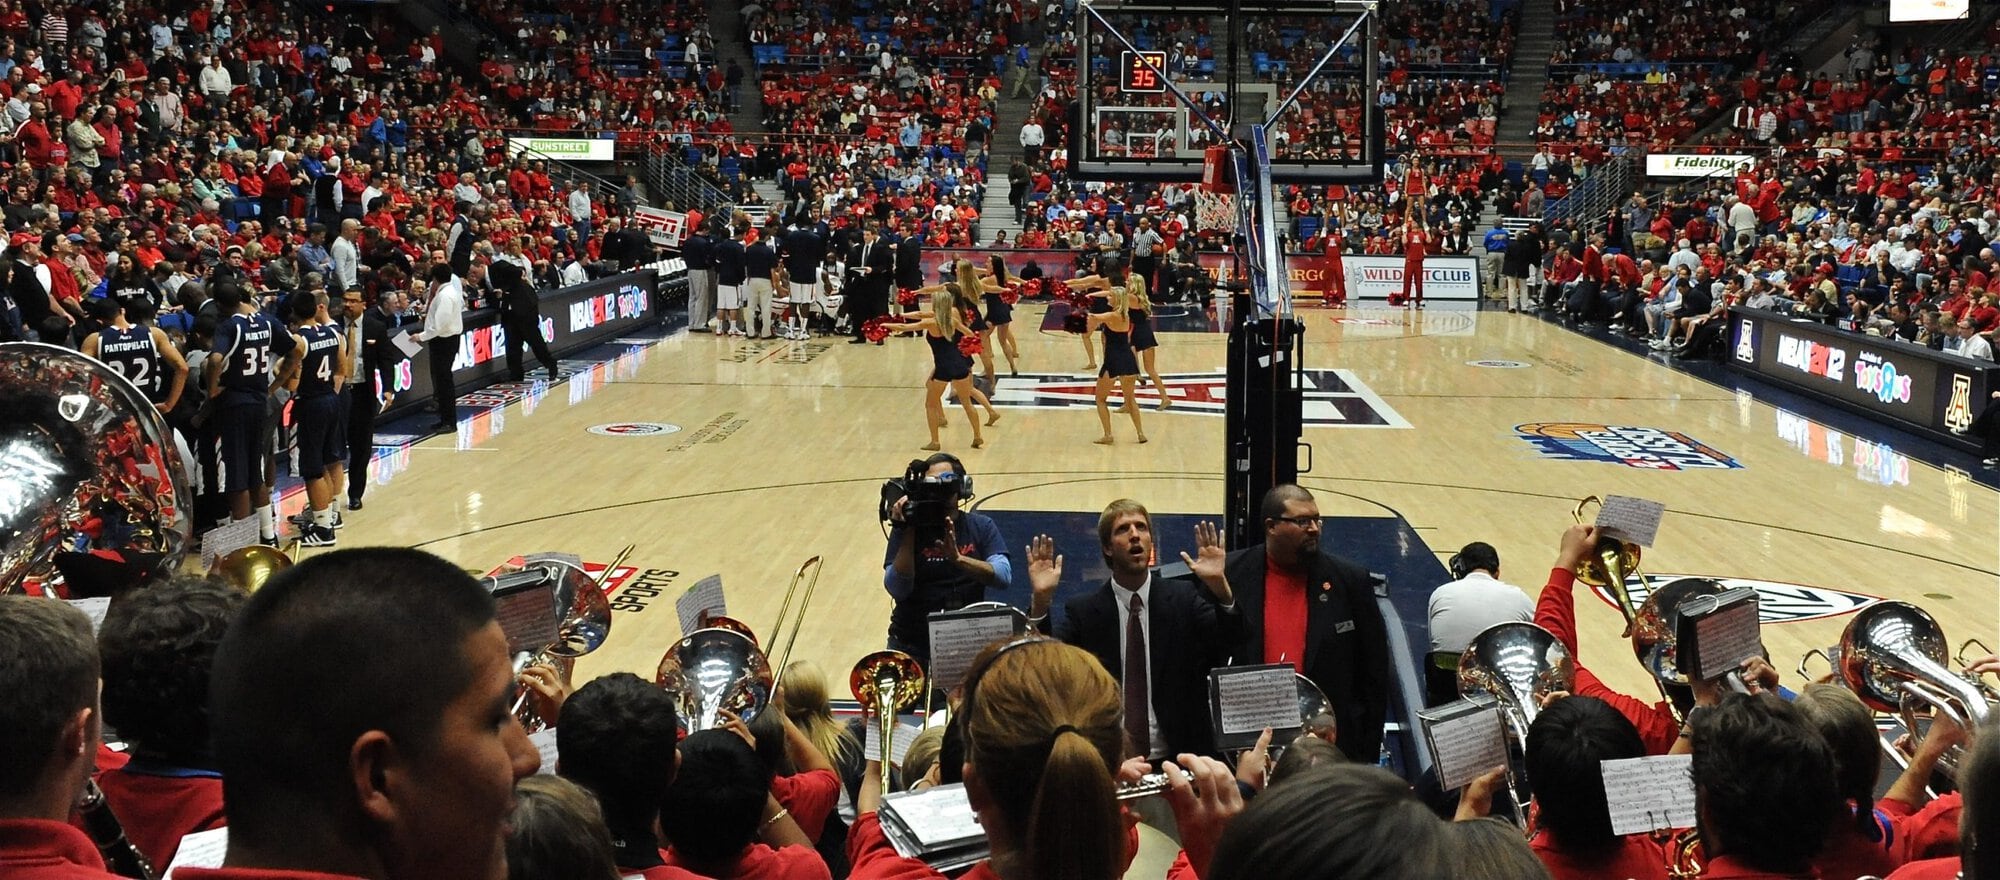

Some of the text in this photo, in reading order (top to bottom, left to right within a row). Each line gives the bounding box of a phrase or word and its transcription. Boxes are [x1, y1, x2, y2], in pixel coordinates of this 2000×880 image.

[1132, 70, 1155, 87] 35
[531, 141, 588, 152] SUNSTREET
[1674, 156, 1735, 170] Fidelity
[245, 329, 270, 342] MARTIN
[310, 337, 339, 352] HERRERA
[1736, 319, 1754, 363] A
[242, 345, 270, 376] 35
[316, 354, 332, 382] 4
[1944, 373, 1973, 432] A
[609, 568, 680, 613] SPORTS
